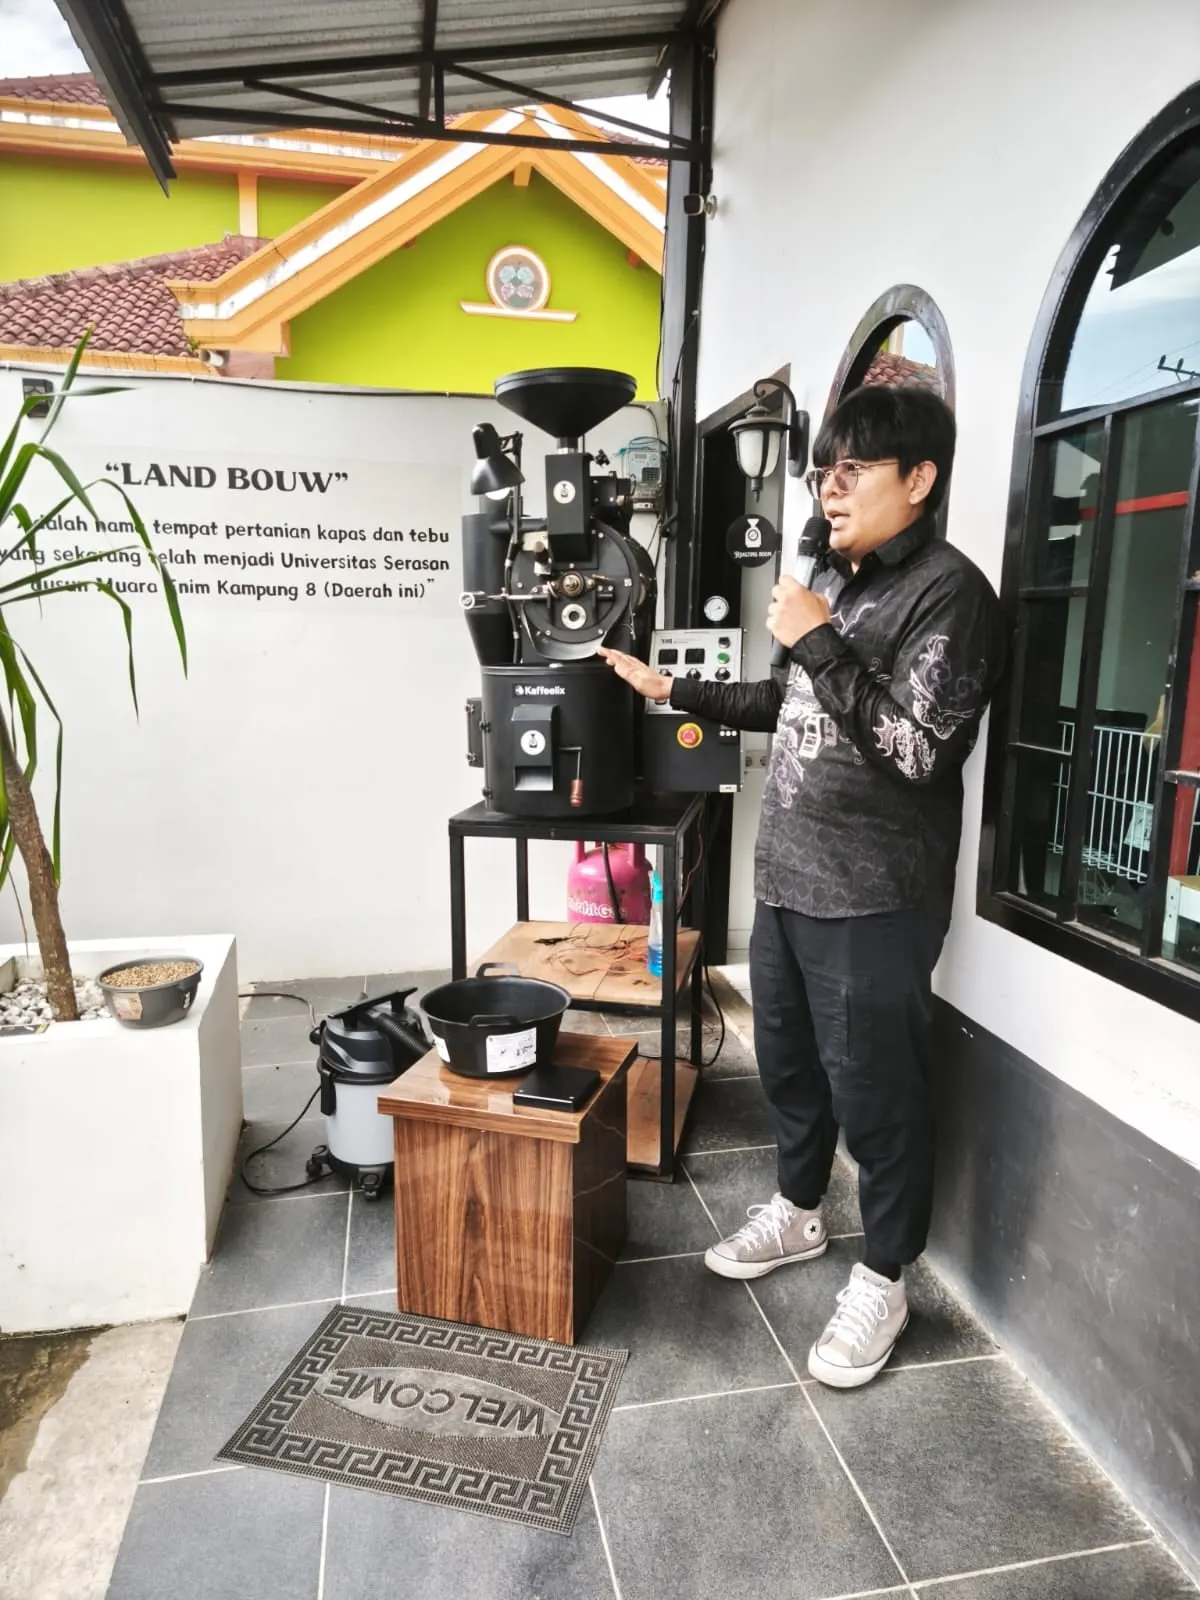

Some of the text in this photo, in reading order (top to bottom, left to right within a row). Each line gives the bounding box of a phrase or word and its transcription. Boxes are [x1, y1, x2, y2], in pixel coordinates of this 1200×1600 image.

[105, 462, 349, 494] “LAND BOUW”
[95, 519, 138, 534] nam
[153, 519, 218, 539] tempat
[225, 522, 311, 539] pertanian
[317, 524, 367, 543] kapas
[373, 526, 404, 542] dan
[409, 527, 449, 543] tebu
[157, 548, 197, 565] elah
[203, 551, 275, 570] menjadi
[281, 551, 377, 569] Universitas
[383, 555, 450, 571] Serasan
[171, 578, 210, 594] nim
[217, 579, 299, 601] Kampung
[305, 582, 317, 597] 8
[324, 581, 393, 598] (Daerah
[324, 1369, 544, 1435] WELCOME
